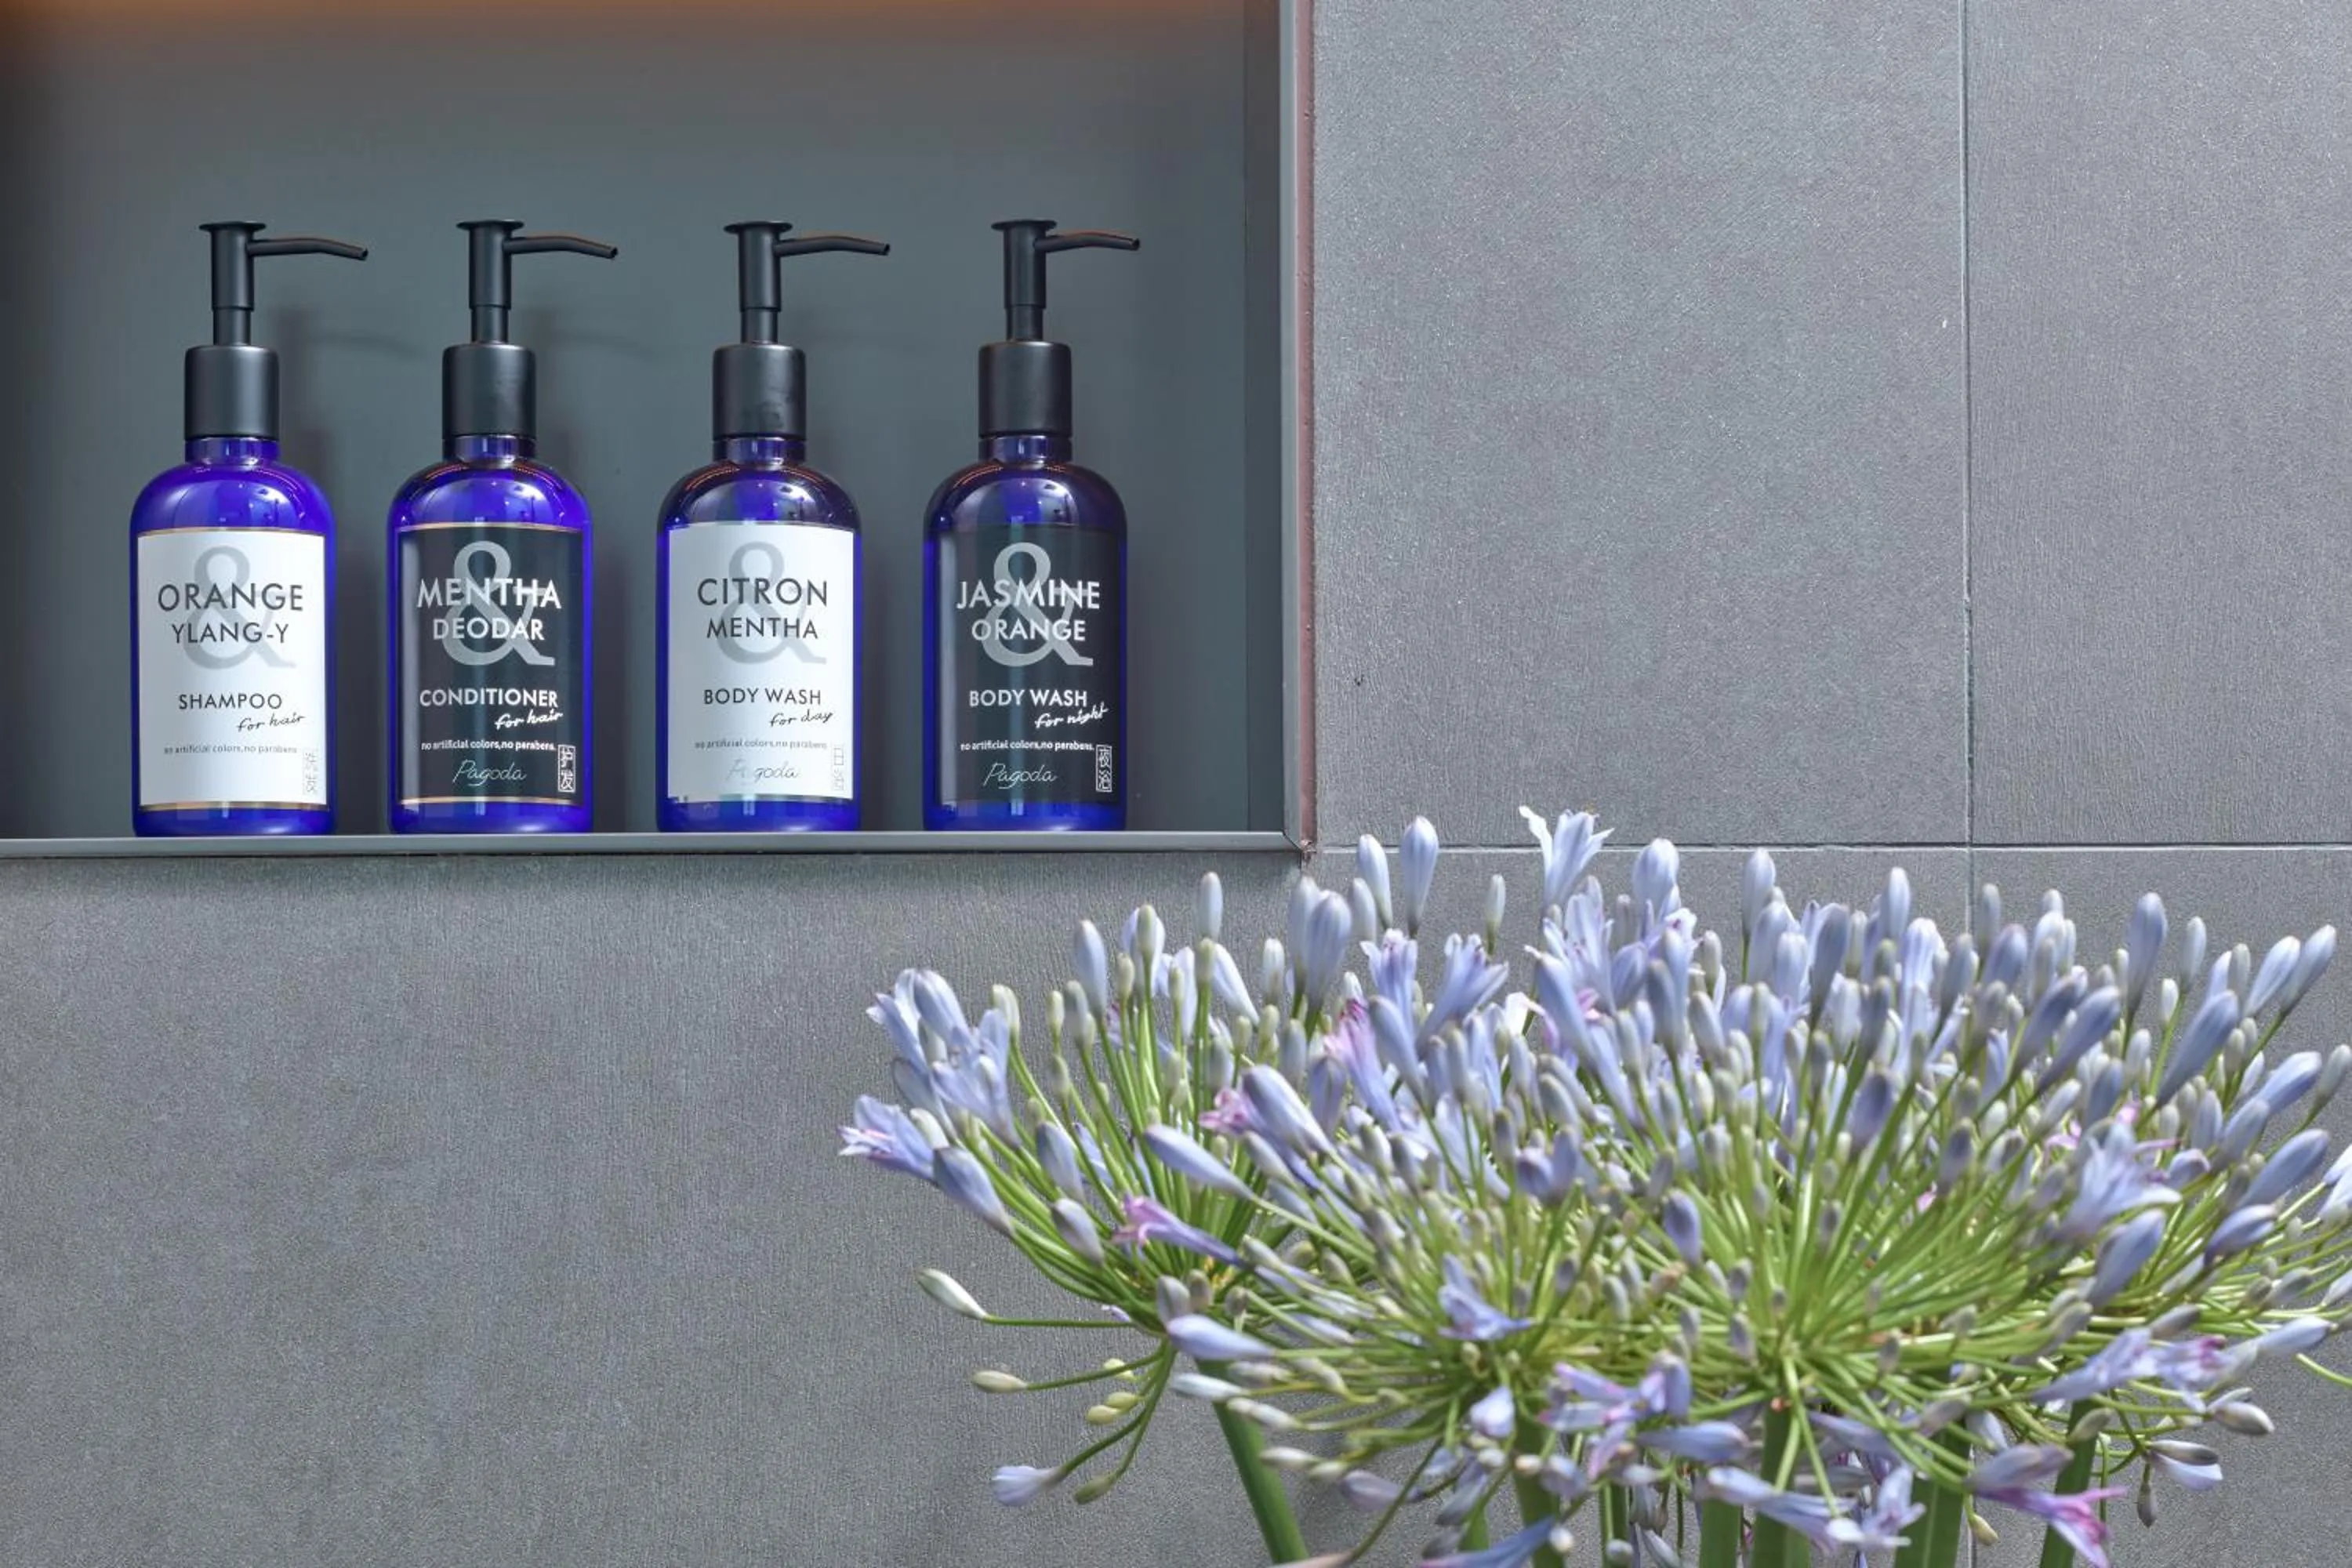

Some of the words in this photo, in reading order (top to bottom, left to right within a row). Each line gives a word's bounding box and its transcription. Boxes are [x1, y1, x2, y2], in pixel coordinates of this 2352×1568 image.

[158, 583, 303, 612] ORANGE
[417, 577, 562, 609] MENTHA
[697, 577, 827, 607] CITRON
[956, 577, 1100, 609] JASMINE
[172, 622, 289, 644] YLANG-Y
[433, 616, 546, 641] DEODAR
[706, 617, 818, 640] MENTHA
[971, 618, 1086, 641] ORANGE
[179, 692, 282, 710] SHAMPOO
[419, 688, 559, 708] CONDITIONER
[704, 687, 759, 705] BODY
[764, 688, 821, 705] WASH
[969, 689, 1025, 707] BODY
[1029, 689, 1088, 707] WASH
[236, 717, 265, 732] for
[269, 712, 305, 728] hair
[494, 713, 524, 730] for
[526, 709, 564, 724] hair
[769, 713, 797, 728] for
[800, 708, 834, 724] day
[1034, 712, 1064, 729] for
[1067, 702, 1109, 724] night
[421, 742, 431, 751] no
[433, 739, 469, 750] artificial
[971, 740, 1008, 750] artificial
[452, 759, 528, 786] Pagoda
[983, 762, 1058, 789] Pagoda
